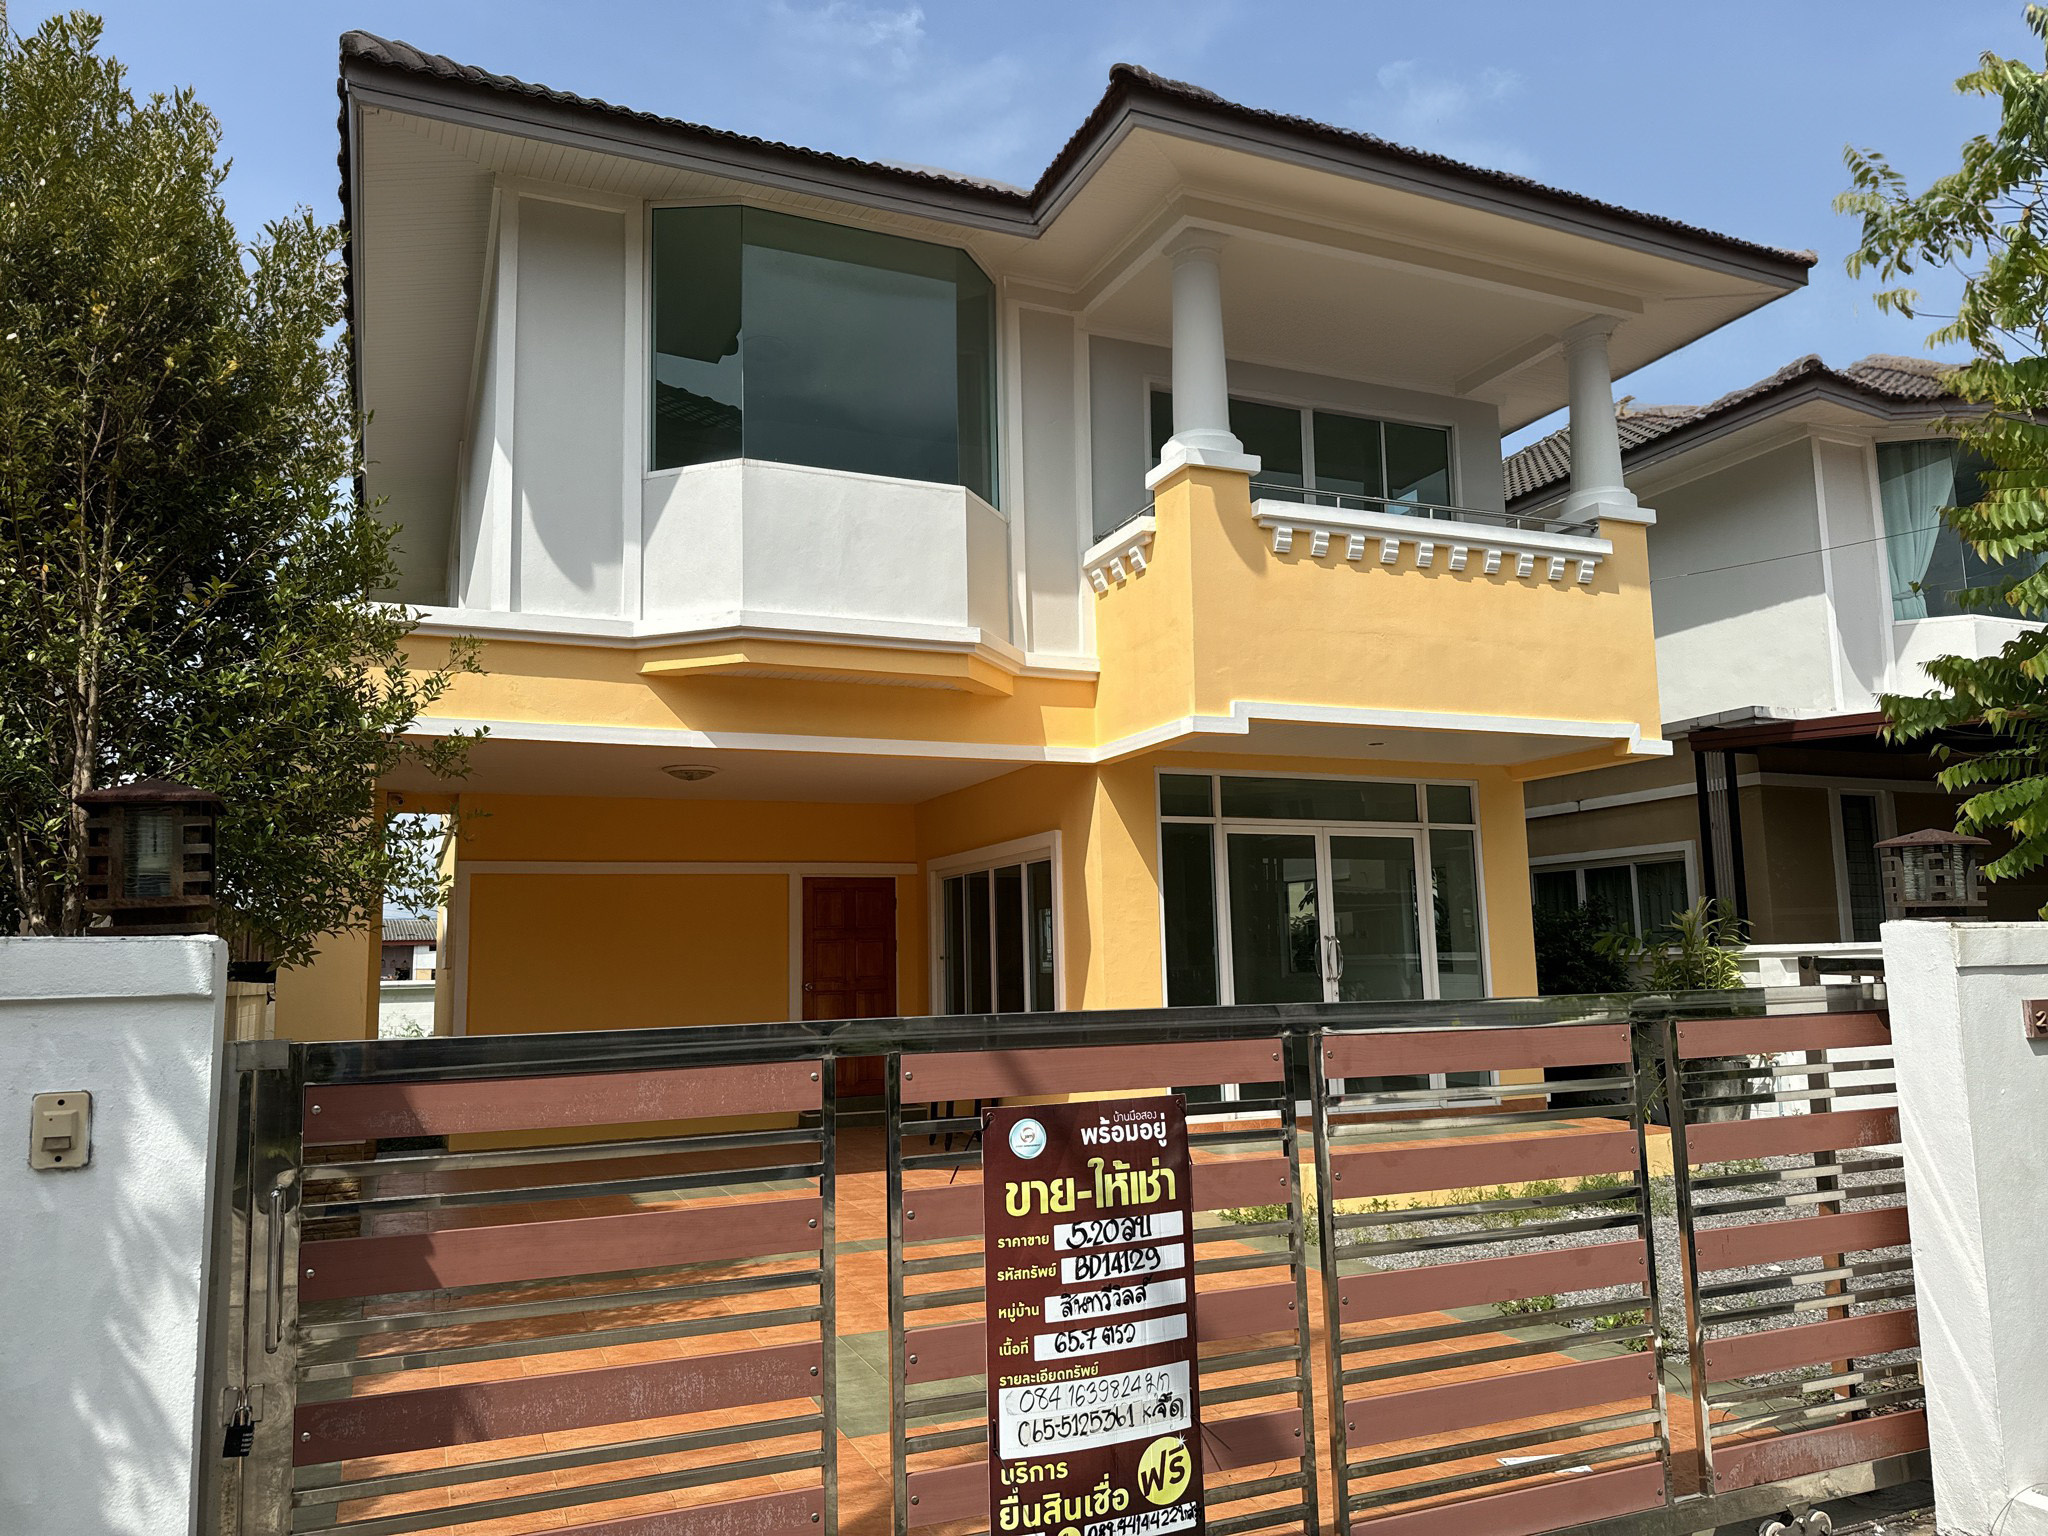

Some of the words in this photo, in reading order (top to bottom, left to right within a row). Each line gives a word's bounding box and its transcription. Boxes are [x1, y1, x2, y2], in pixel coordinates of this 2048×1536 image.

[1113, 1110, 1157, 1123] บ้านมือสอง
[1080, 1112, 1167, 1147] พร้อมอยู่
[1005, 1156, 1177, 1217] ขาย-ให้เช่า
[997, 1233, 1050, 1248] ราคาขาย
[997, 1262, 1057, 1282] รหัสทรัพย์
[1074, 1247, 1161, 1280] BD14129
[998, 1303, 1040, 1323] หมู่บ้าน
[999, 1336, 1029, 1357] เนื้อที่
[999, 1361, 1099, 1386] รายละเอียดทรัพย์
[1000, 1461, 1068, 1485] บริการ
[1140, 1445, 1186, 1496] ฟรี
[1000, 1473, 1129, 1531] ยื่นสินเชื่อ
